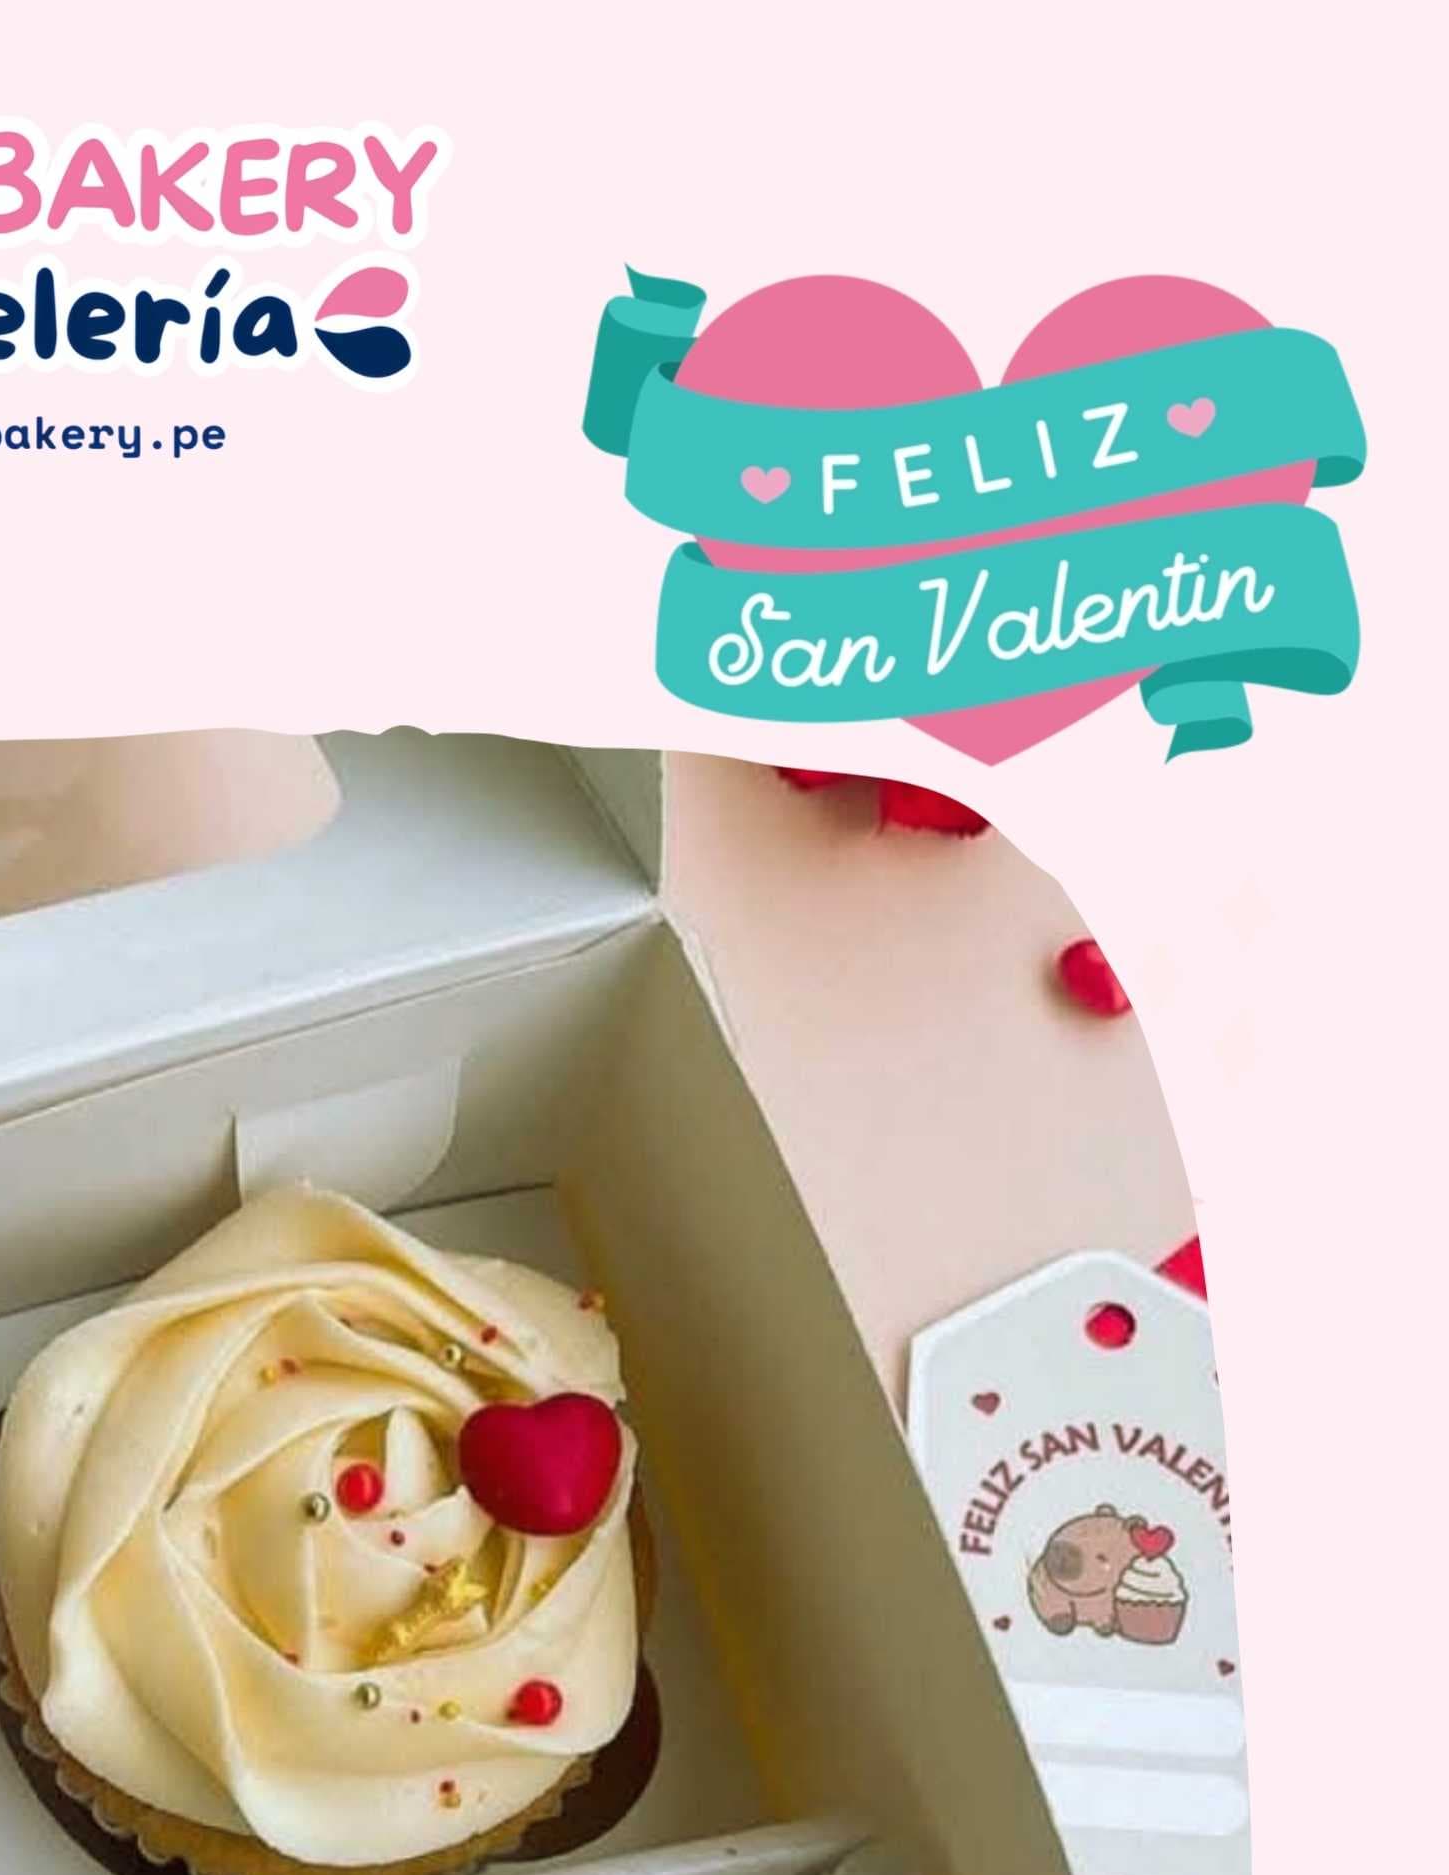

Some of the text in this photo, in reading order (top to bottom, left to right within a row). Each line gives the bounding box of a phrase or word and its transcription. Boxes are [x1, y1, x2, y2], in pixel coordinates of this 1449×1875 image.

[960, 1421, 1232, 1557] FELIZ SAN VALEN
